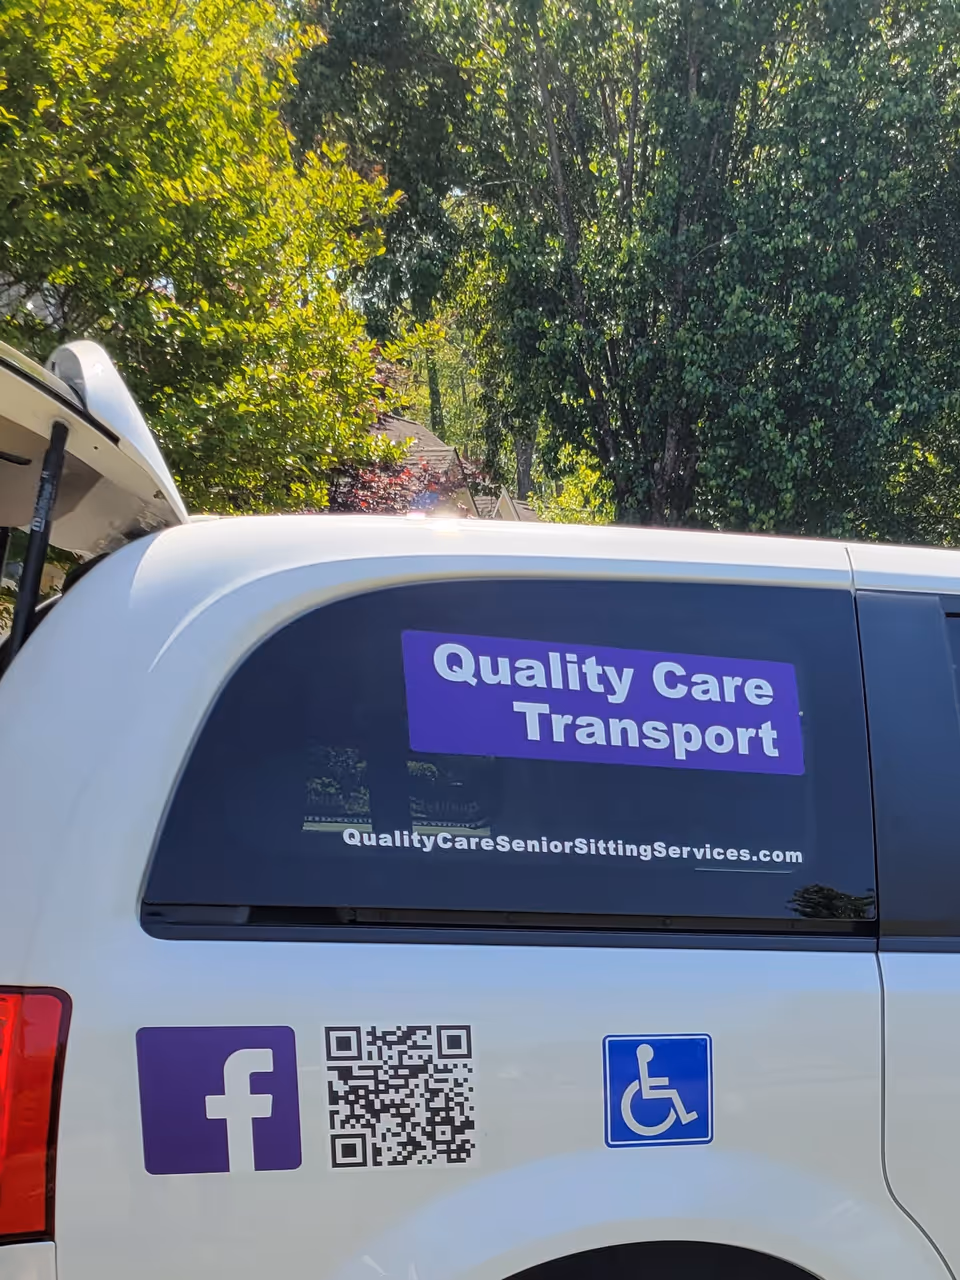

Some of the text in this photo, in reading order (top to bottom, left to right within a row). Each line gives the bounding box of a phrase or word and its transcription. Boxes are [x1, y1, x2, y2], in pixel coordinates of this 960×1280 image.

[433, 642, 774, 706] Quality Care
[512, 701, 780, 761] Transport
[342, 827, 803, 863] QualityCareSeniorSittingServices.com
